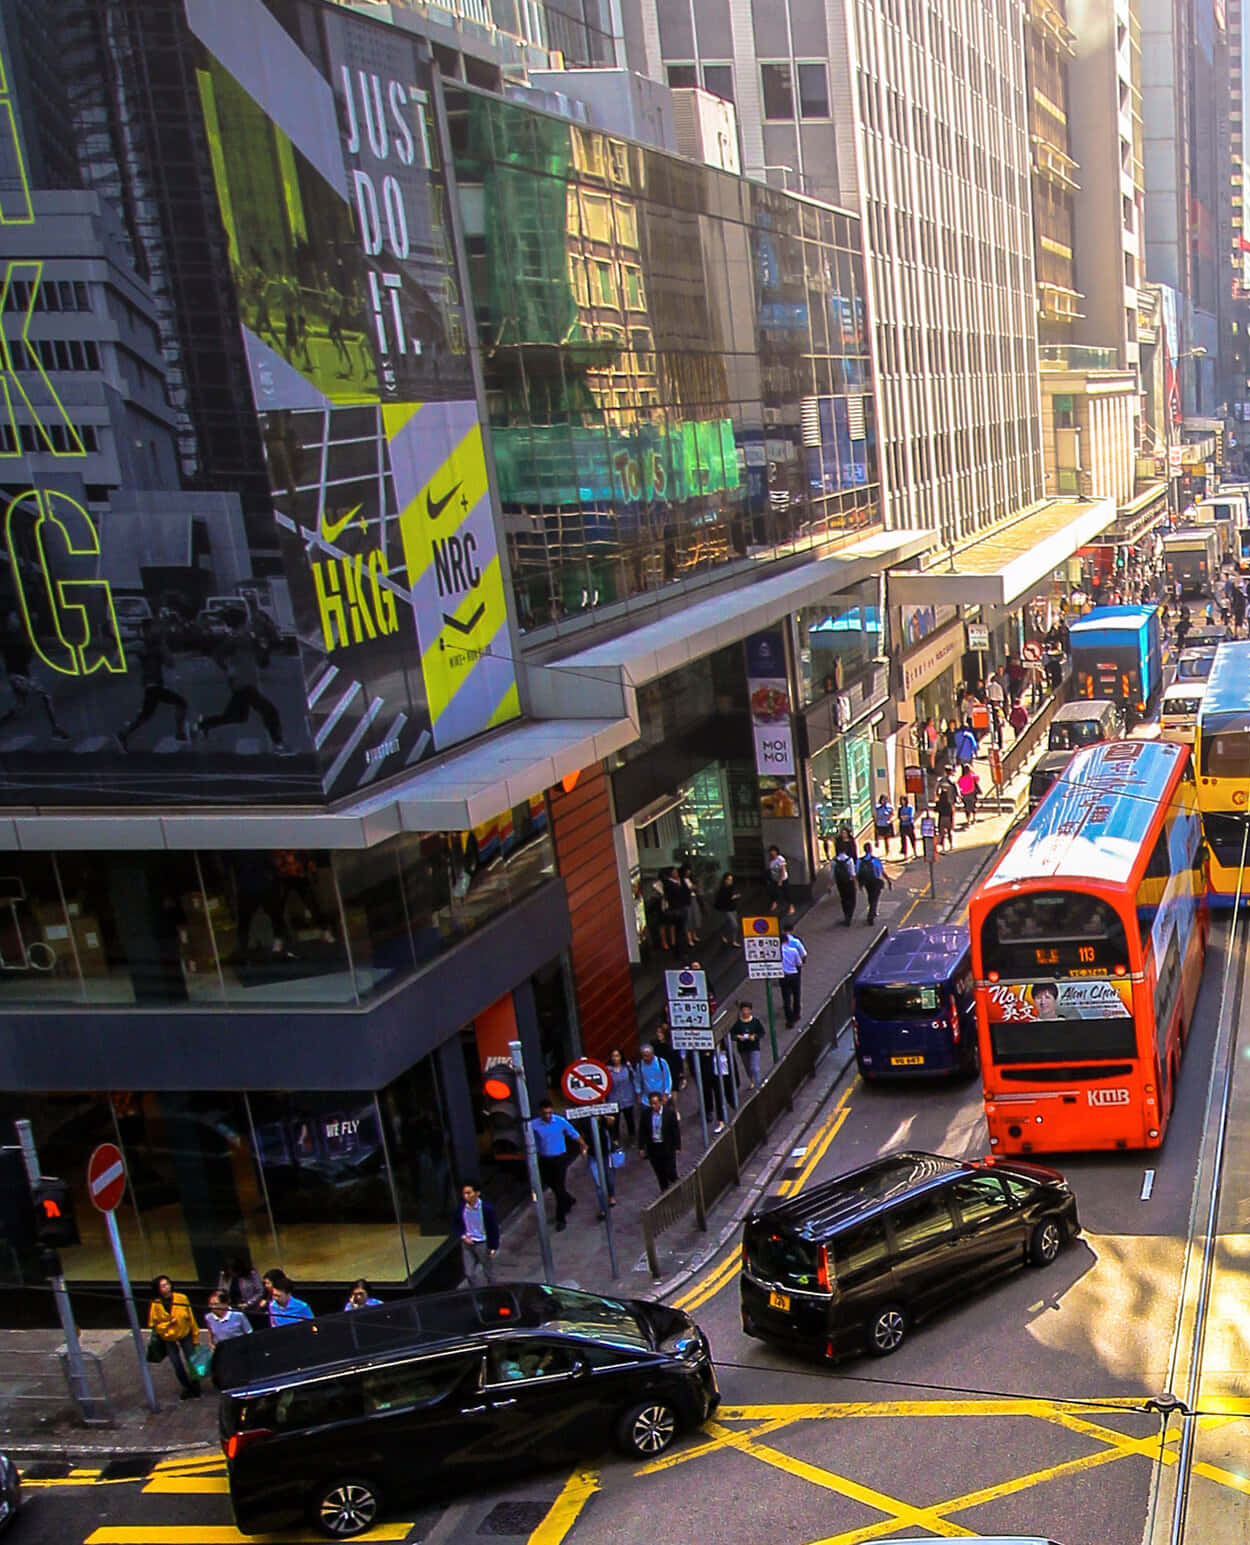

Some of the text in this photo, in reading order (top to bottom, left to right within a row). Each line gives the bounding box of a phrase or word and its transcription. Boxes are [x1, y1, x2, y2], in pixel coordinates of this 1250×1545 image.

[341, 65, 431, 169] JUST
[353, 169, 409, 260] DO
[368, 271, 422, 355] IT.
[432, 532, 481, 597] NRC
[312, 548, 399, 652] HKG
[762, 740, 787, 751] MOI
[764, 752, 788, 763] MOI
[1079, 946, 1095, 963] 113
[988, 984, 1027, 1006] No.1
[1001, 1001, 1035, 1022] 英文
[1087, 1088, 1130, 1107] KMB
[341, 1119, 360, 1136] FLY
